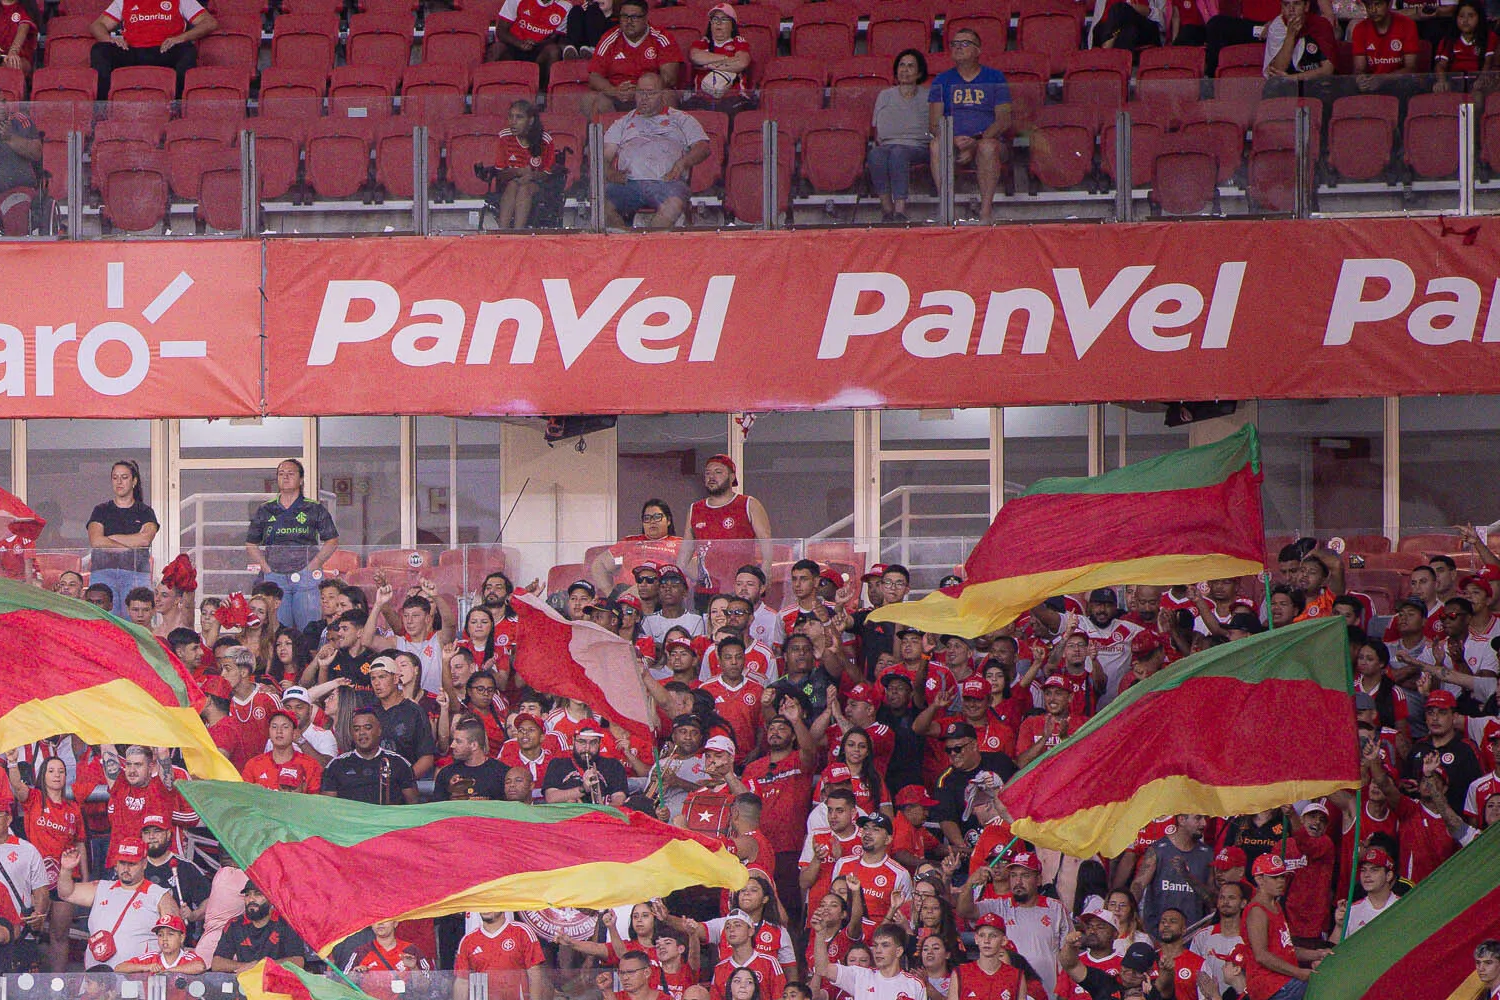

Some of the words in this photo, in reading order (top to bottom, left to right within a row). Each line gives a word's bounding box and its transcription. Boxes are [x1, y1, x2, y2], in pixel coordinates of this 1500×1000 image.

[952, 88, 985, 105] GAP
[306, 274, 736, 371] PanVel
[816, 260, 1248, 360] PanVel
[1161, 879, 1195, 893] Banris
